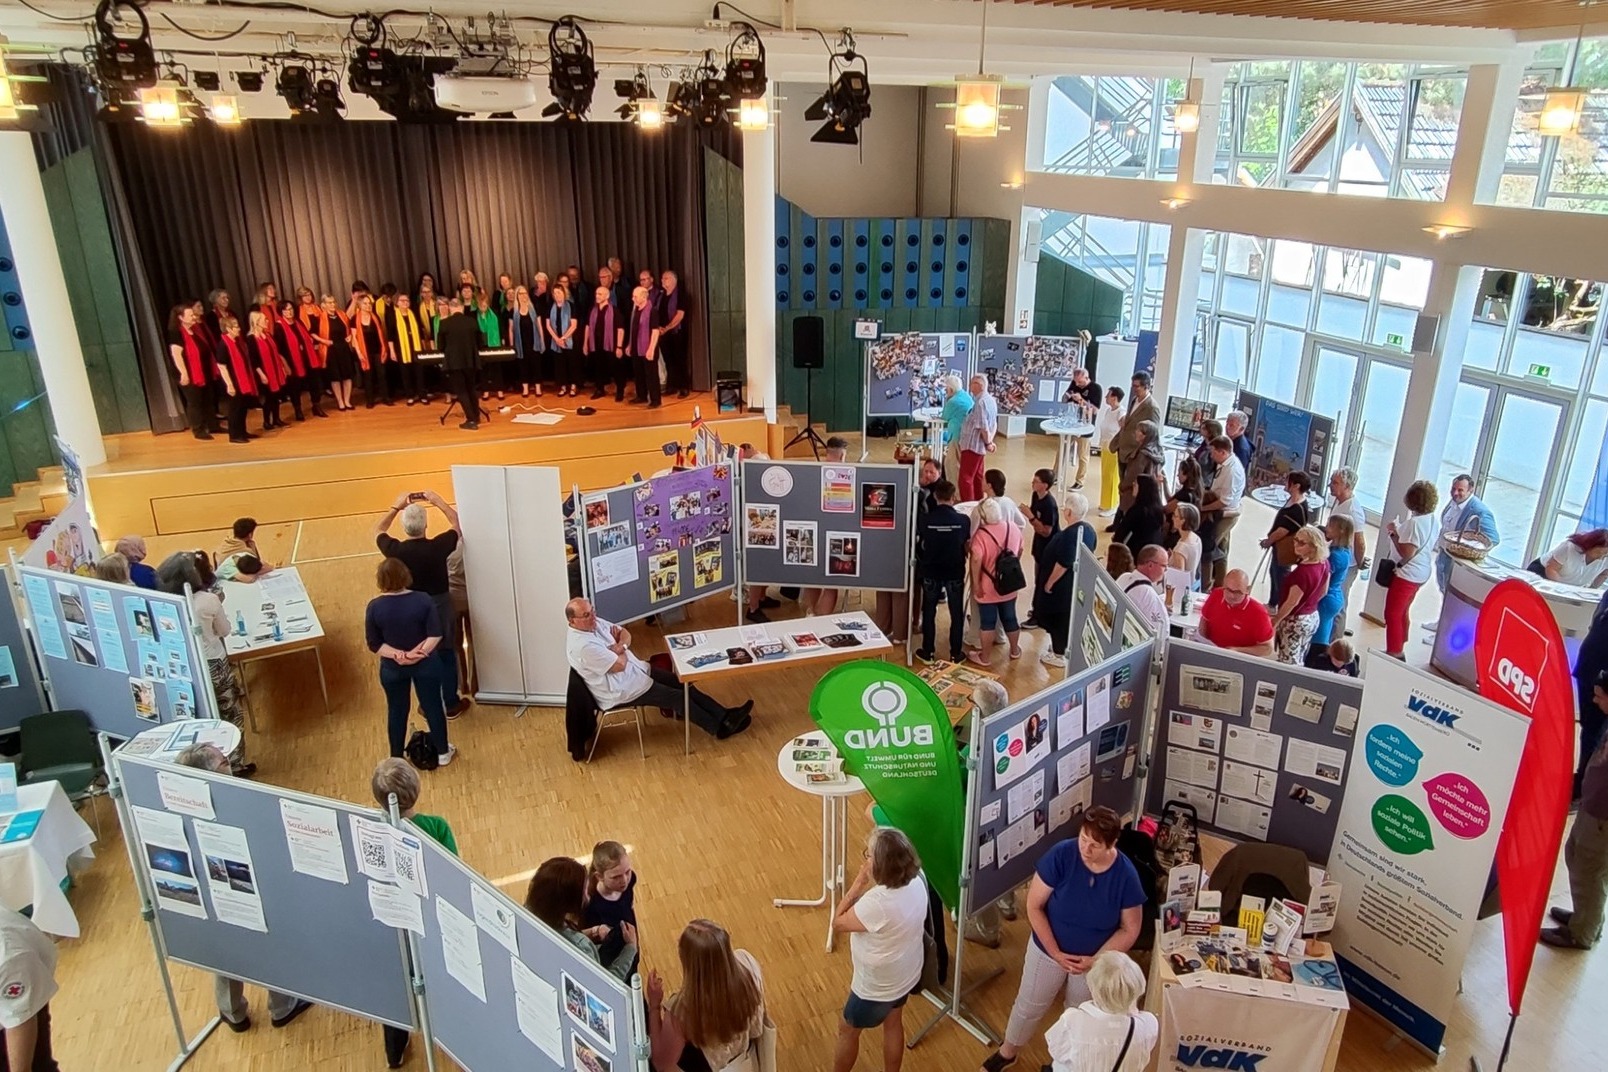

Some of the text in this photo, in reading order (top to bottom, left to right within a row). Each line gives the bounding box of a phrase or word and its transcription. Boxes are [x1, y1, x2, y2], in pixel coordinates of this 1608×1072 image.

[1408, 695, 1461, 729] VdK
[1411, 688, 1464, 715] SOZIALVERBAND
[1369, 734, 1416, 765] fordere meine
[1376, 750, 1403, 769] sozialen
[1431, 793, 1484, 827] Gemeinschaft
[1436, 784, 1488, 816] möchte mehr
[286, 819, 334, 838] Sozialarbeit
[1377, 810, 1426, 841] soziale Politik
[1402, 812, 1414, 823] will
[1343, 830, 1378, 859] Gemeinsam
[1379, 854, 1394, 868] sind
[1346, 843, 1386, 874] Deutschlands
[1386, 868, 1415, 890] größtem
[1416, 886, 1464, 920] Sozialverband.
[1177, 1043, 1269, 1072] VdK
[1179, 1034, 1272, 1052] SOZIALVERBAND
